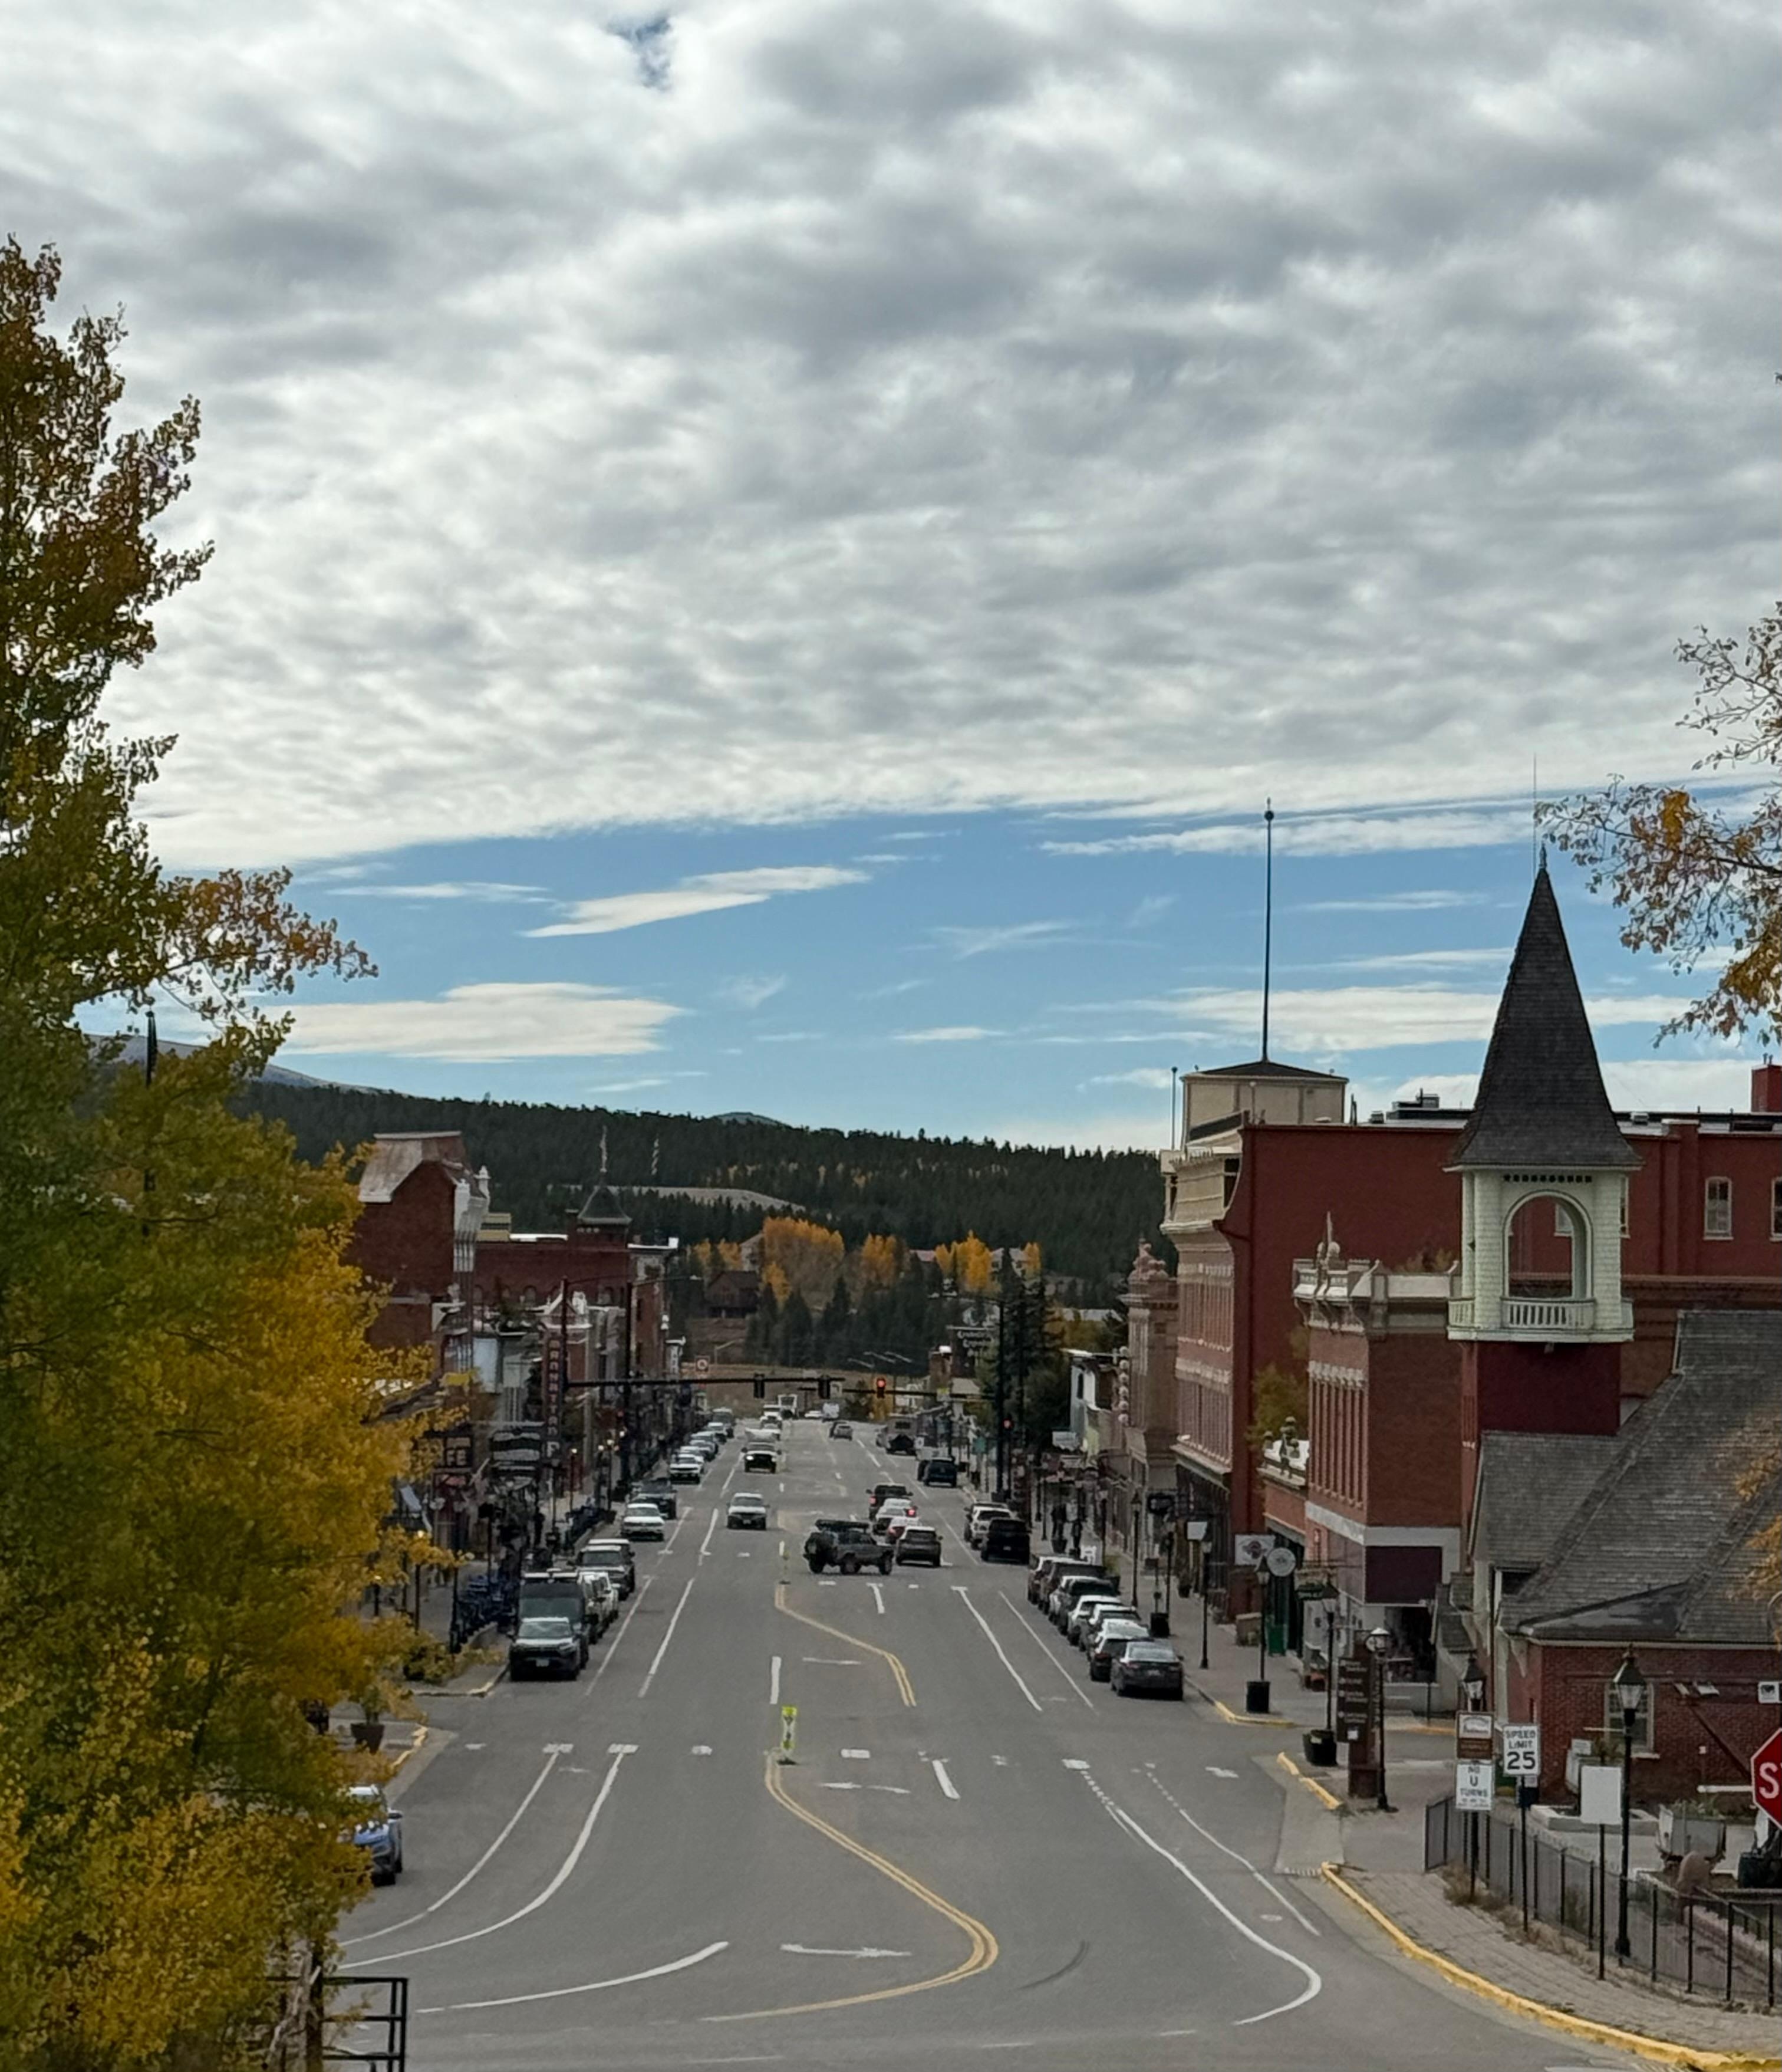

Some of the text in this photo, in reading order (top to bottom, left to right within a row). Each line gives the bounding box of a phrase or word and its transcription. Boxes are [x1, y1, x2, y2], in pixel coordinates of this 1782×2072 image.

[1506, 1730, 1536, 1739] SPEED
[1508, 1740, 1533, 1749] LIMIT
[1507, 1751, 1536, 1770] 25
[1468, 1765, 1480, 1774] NO
[1470, 1775, 1478, 1787] U
[1759, 1762, 1782, 1799] S
[1460, 1788, 1488, 1797] TURNS
